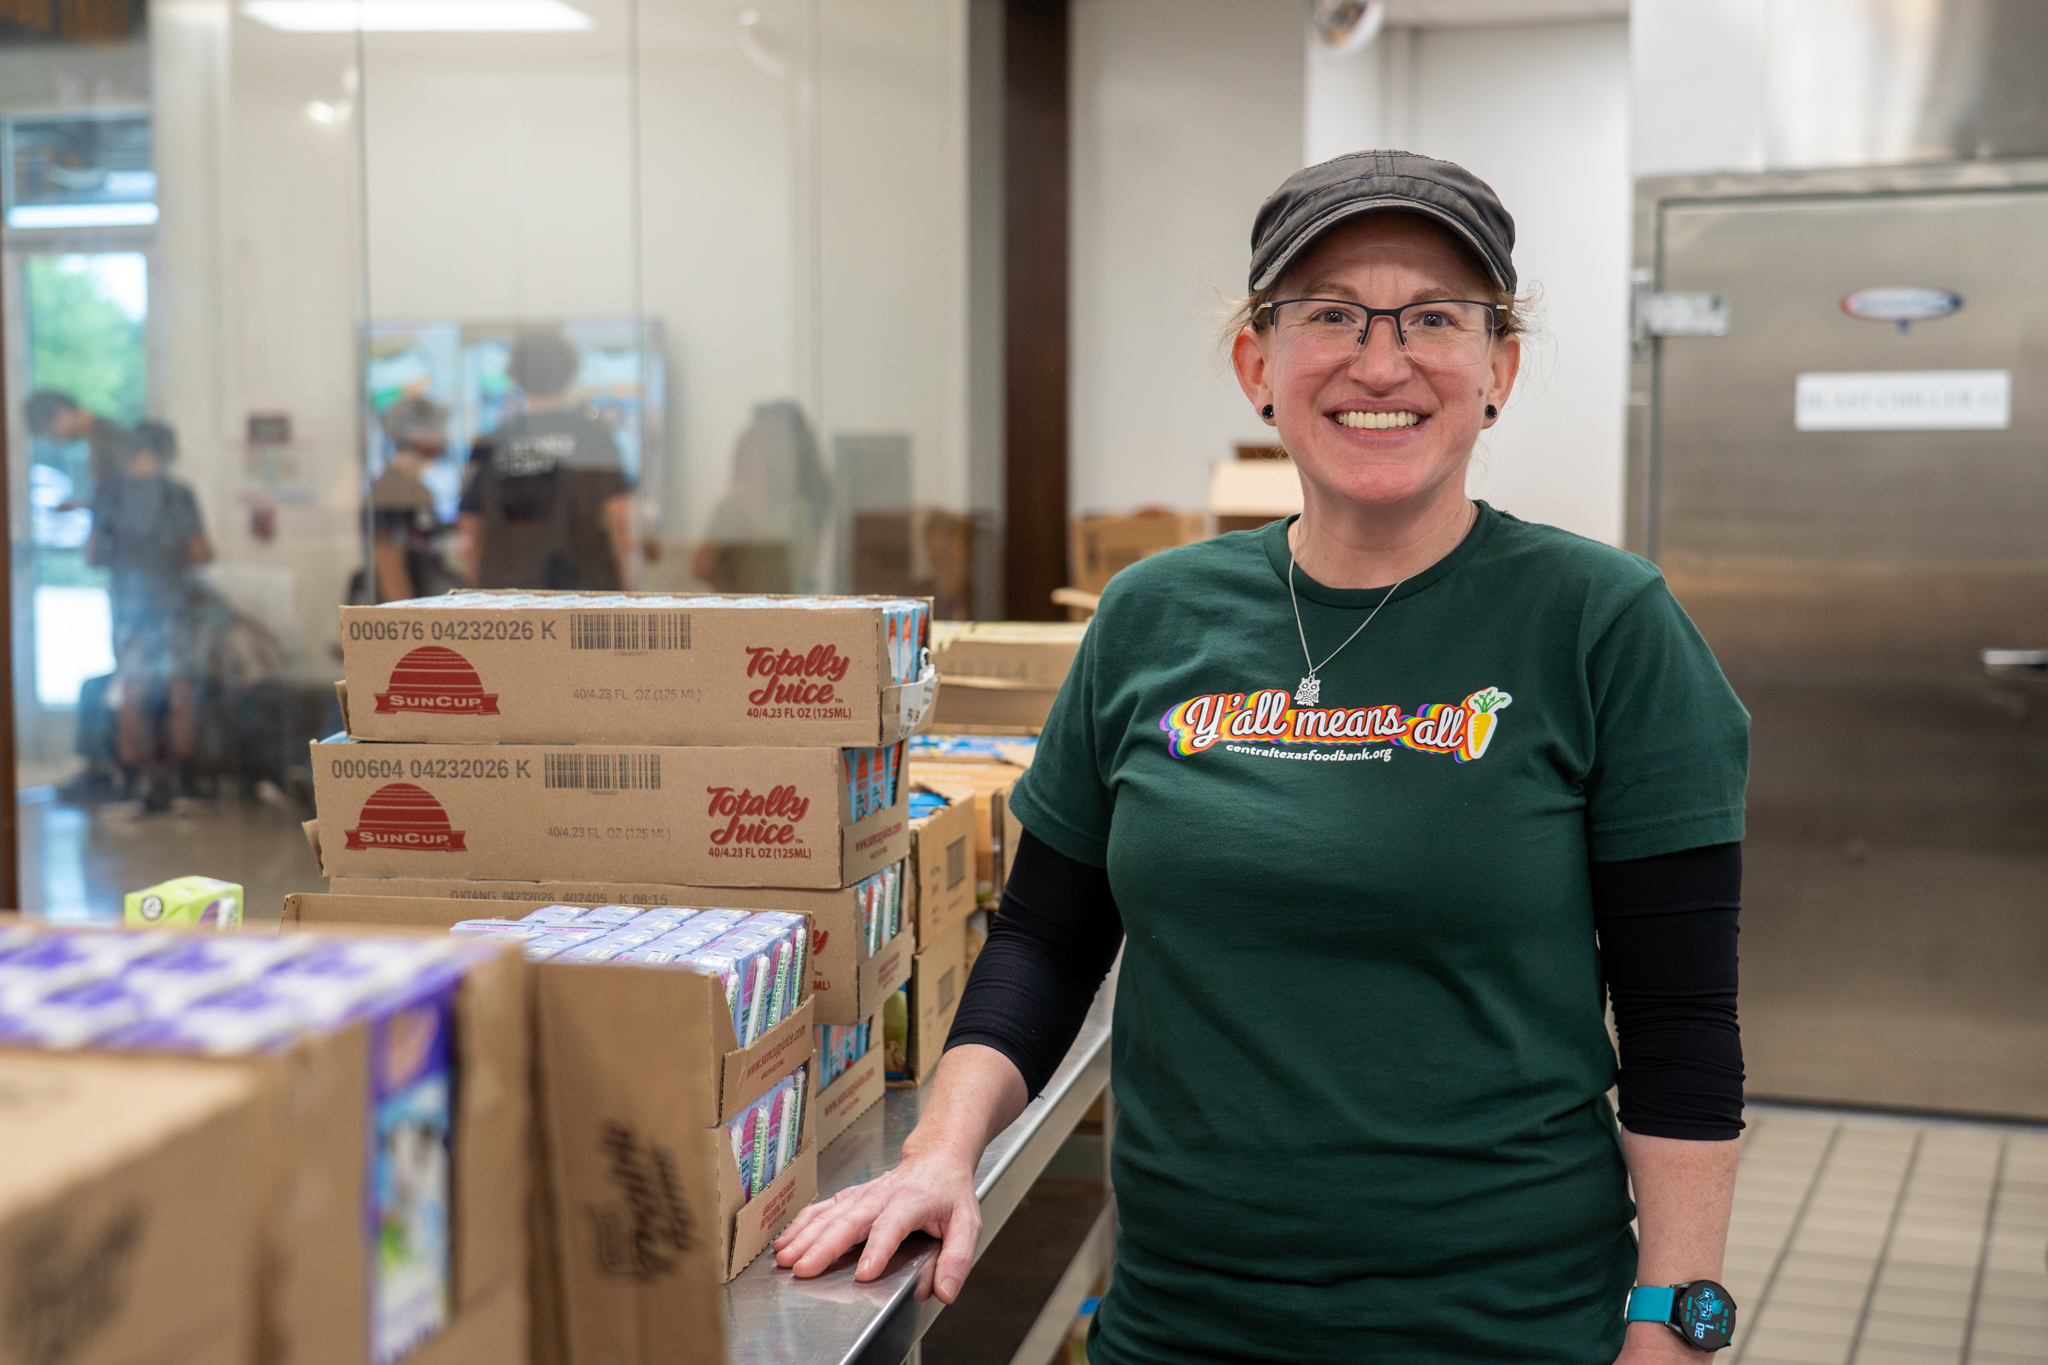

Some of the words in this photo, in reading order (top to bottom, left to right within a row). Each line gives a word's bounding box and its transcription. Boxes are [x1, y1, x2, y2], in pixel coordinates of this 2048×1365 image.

[349, 620, 425, 641] 000676
[431, 620, 535, 641] 04232026
[541, 620, 558, 640] K
[745, 643, 851, 683] Totally
[573, 688, 612, 701] 40/4.23
[634, 689, 651, 701] OZ
[748, 674, 836, 707] Juice
[746, 708, 783, 719] 40/4.23
[784, 708, 796, 719] FL
[797, 708, 812, 719] OZ
[813, 708, 852, 720] (125ML)
[1184, 689, 1290, 749] Y'all
[1292, 704, 1407, 739] means
[1413, 705, 1466, 749] all
[1225, 743, 1393, 762] centraltexasfoodbank.org
[331, 759, 405, 779] 000604
[410, 759, 509, 779] 04232026
[516, 759, 532, 779] K
[706, 784, 811, 824] Totally
[547, 827, 585, 838] 40/4.23
[607, 827, 622, 839] OZ
[709, 813, 796, 846] Juice
[708, 847, 744, 859] 40/4.23
[745, 848, 757, 859] FL
[758, 848, 773, 859] OZ
[774, 847, 812, 860] (125ML)
[752, 1125, 764, 1174] RECYCLABLE
[1694, 1322, 1705, 1339] 02
